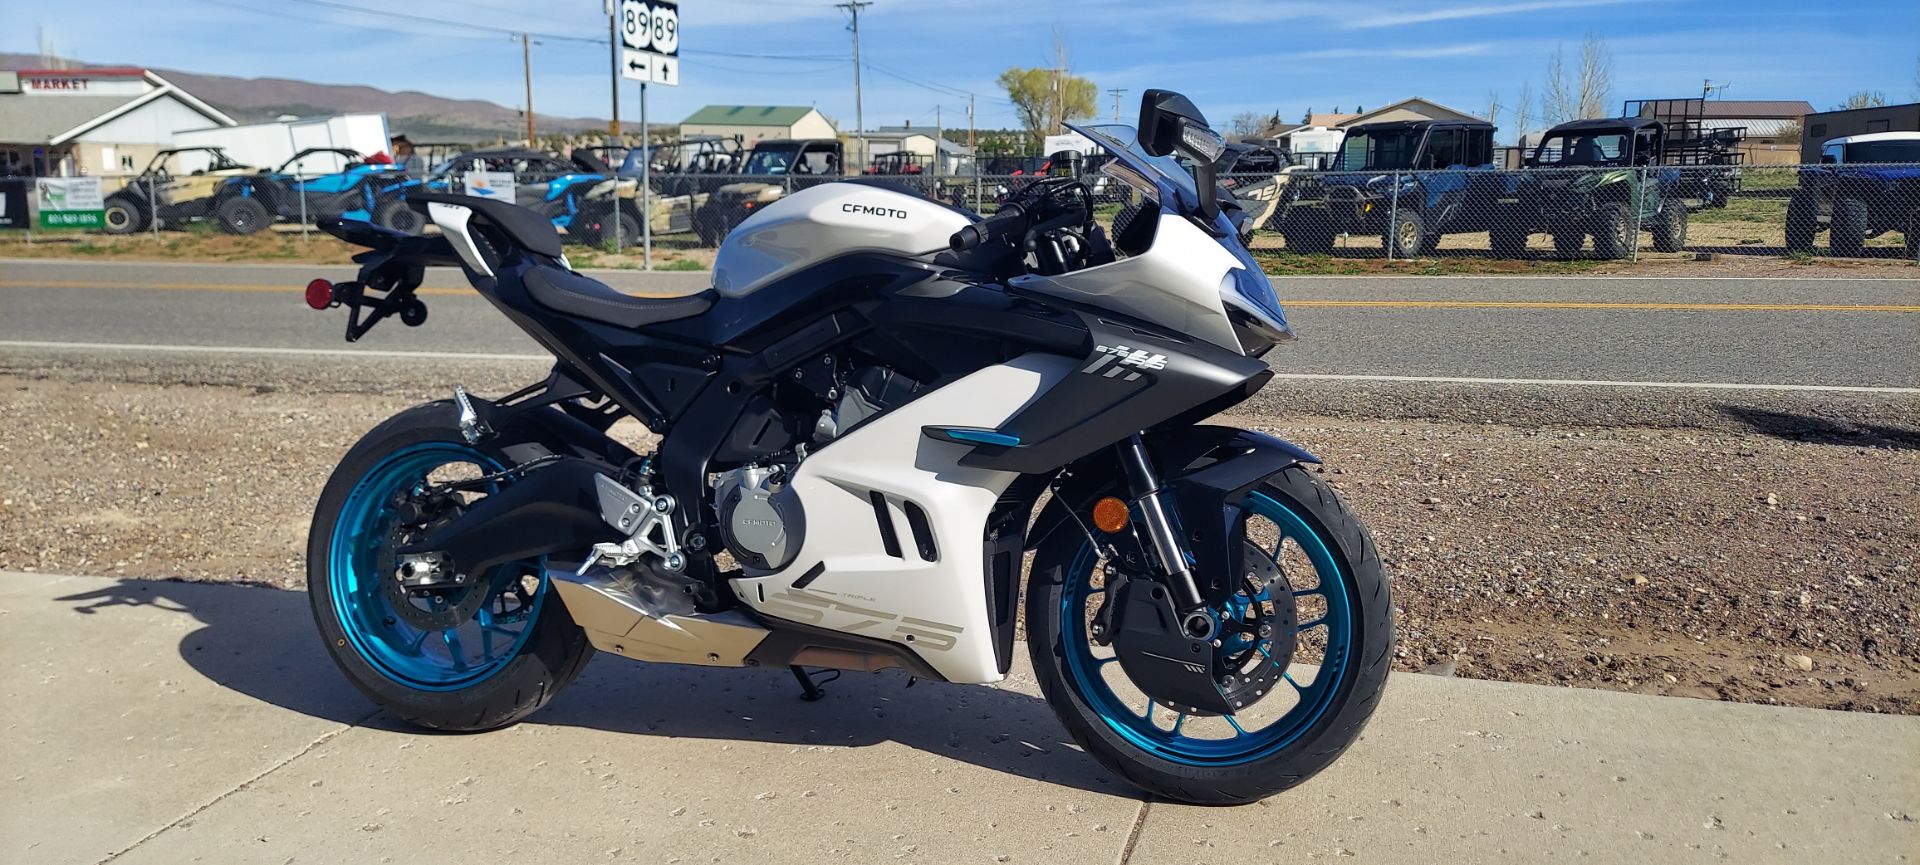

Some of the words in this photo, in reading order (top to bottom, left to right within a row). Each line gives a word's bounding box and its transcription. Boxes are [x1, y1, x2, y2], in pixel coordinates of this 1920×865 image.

[626, 9, 648, 36] 89
[655, 16, 675, 42] 89
[31, 78, 89, 89] MARKET
[842, 203, 907, 219] CFMOTO
[843, 592, 876, 602] TRIPLE
